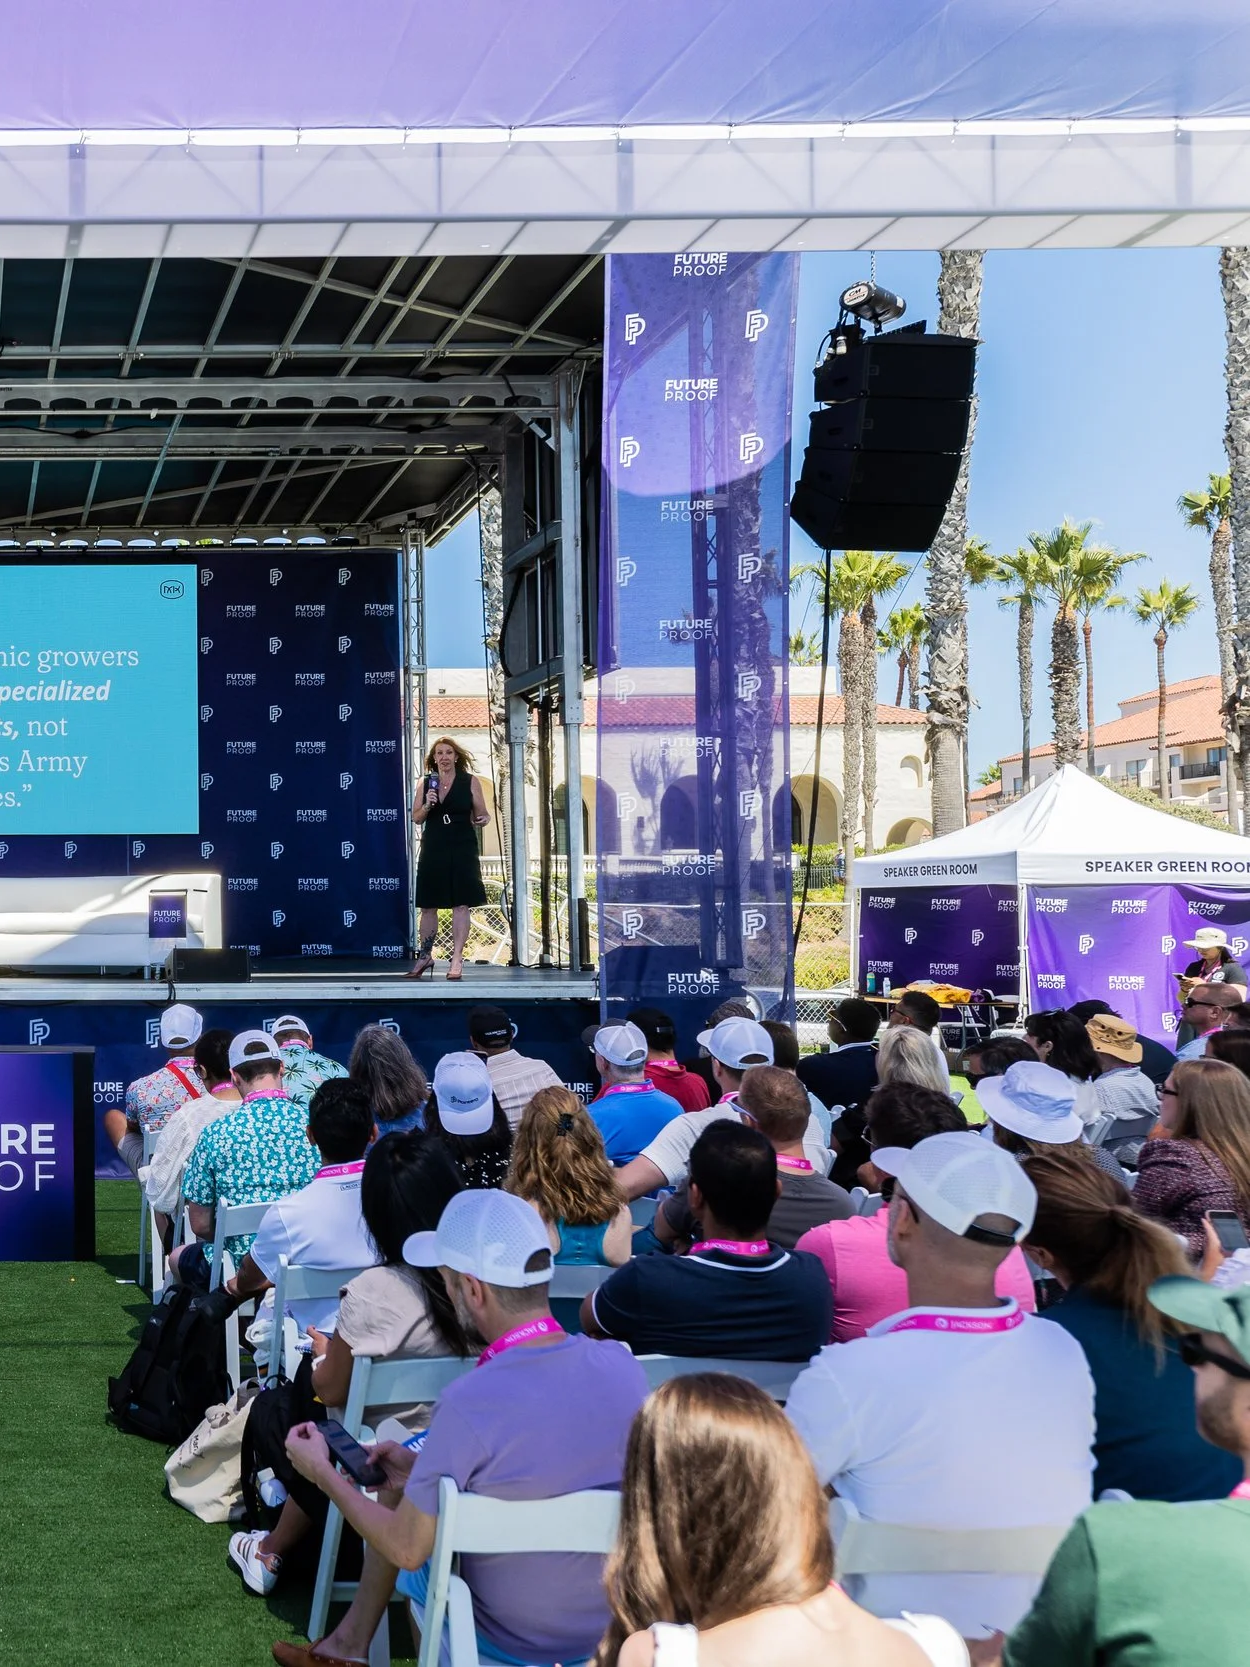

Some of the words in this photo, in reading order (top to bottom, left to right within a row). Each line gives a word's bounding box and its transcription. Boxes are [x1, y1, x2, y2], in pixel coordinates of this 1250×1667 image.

[674, 253, 727, 264] FUTURE
[674, 265, 726, 276] PROOF
[666, 379, 718, 390] FUTURE
[665, 390, 717, 401] PROOF
[662, 500, 713, 510] FUTURE
[661, 511, 712, 521] PROOF
[659, 619, 712, 629] FUTURE
[659, 630, 711, 640] PROOF
[38, 650, 139, 673] growers
[27, 718, 68, 736] not
[17, 750, 87, 778] Army
[662, 855, 715, 865] FUTURE
[662, 865, 715, 875] PROOF
[884, 867, 918, 877] SPEAKER
[920, 865, 947, 875] GREEN
[950, 864, 977, 874] ROOM
[1086, 861, 1153, 872] SPEAKER
[1157, 861, 1207, 872] GREEN
[1036, 898, 1068, 906] FUTURE
[1188, 901, 1225, 910] FUTURE
[1188, 906, 1222, 915] PROOF
[668, 973, 719, 983] FUTURE
[1038, 974, 1065, 982] FUTURE
[669, 985, 719, 994] PROOF
[94, 1082, 123, 1091] TURE
[94, 1093, 123, 1102] OOF
